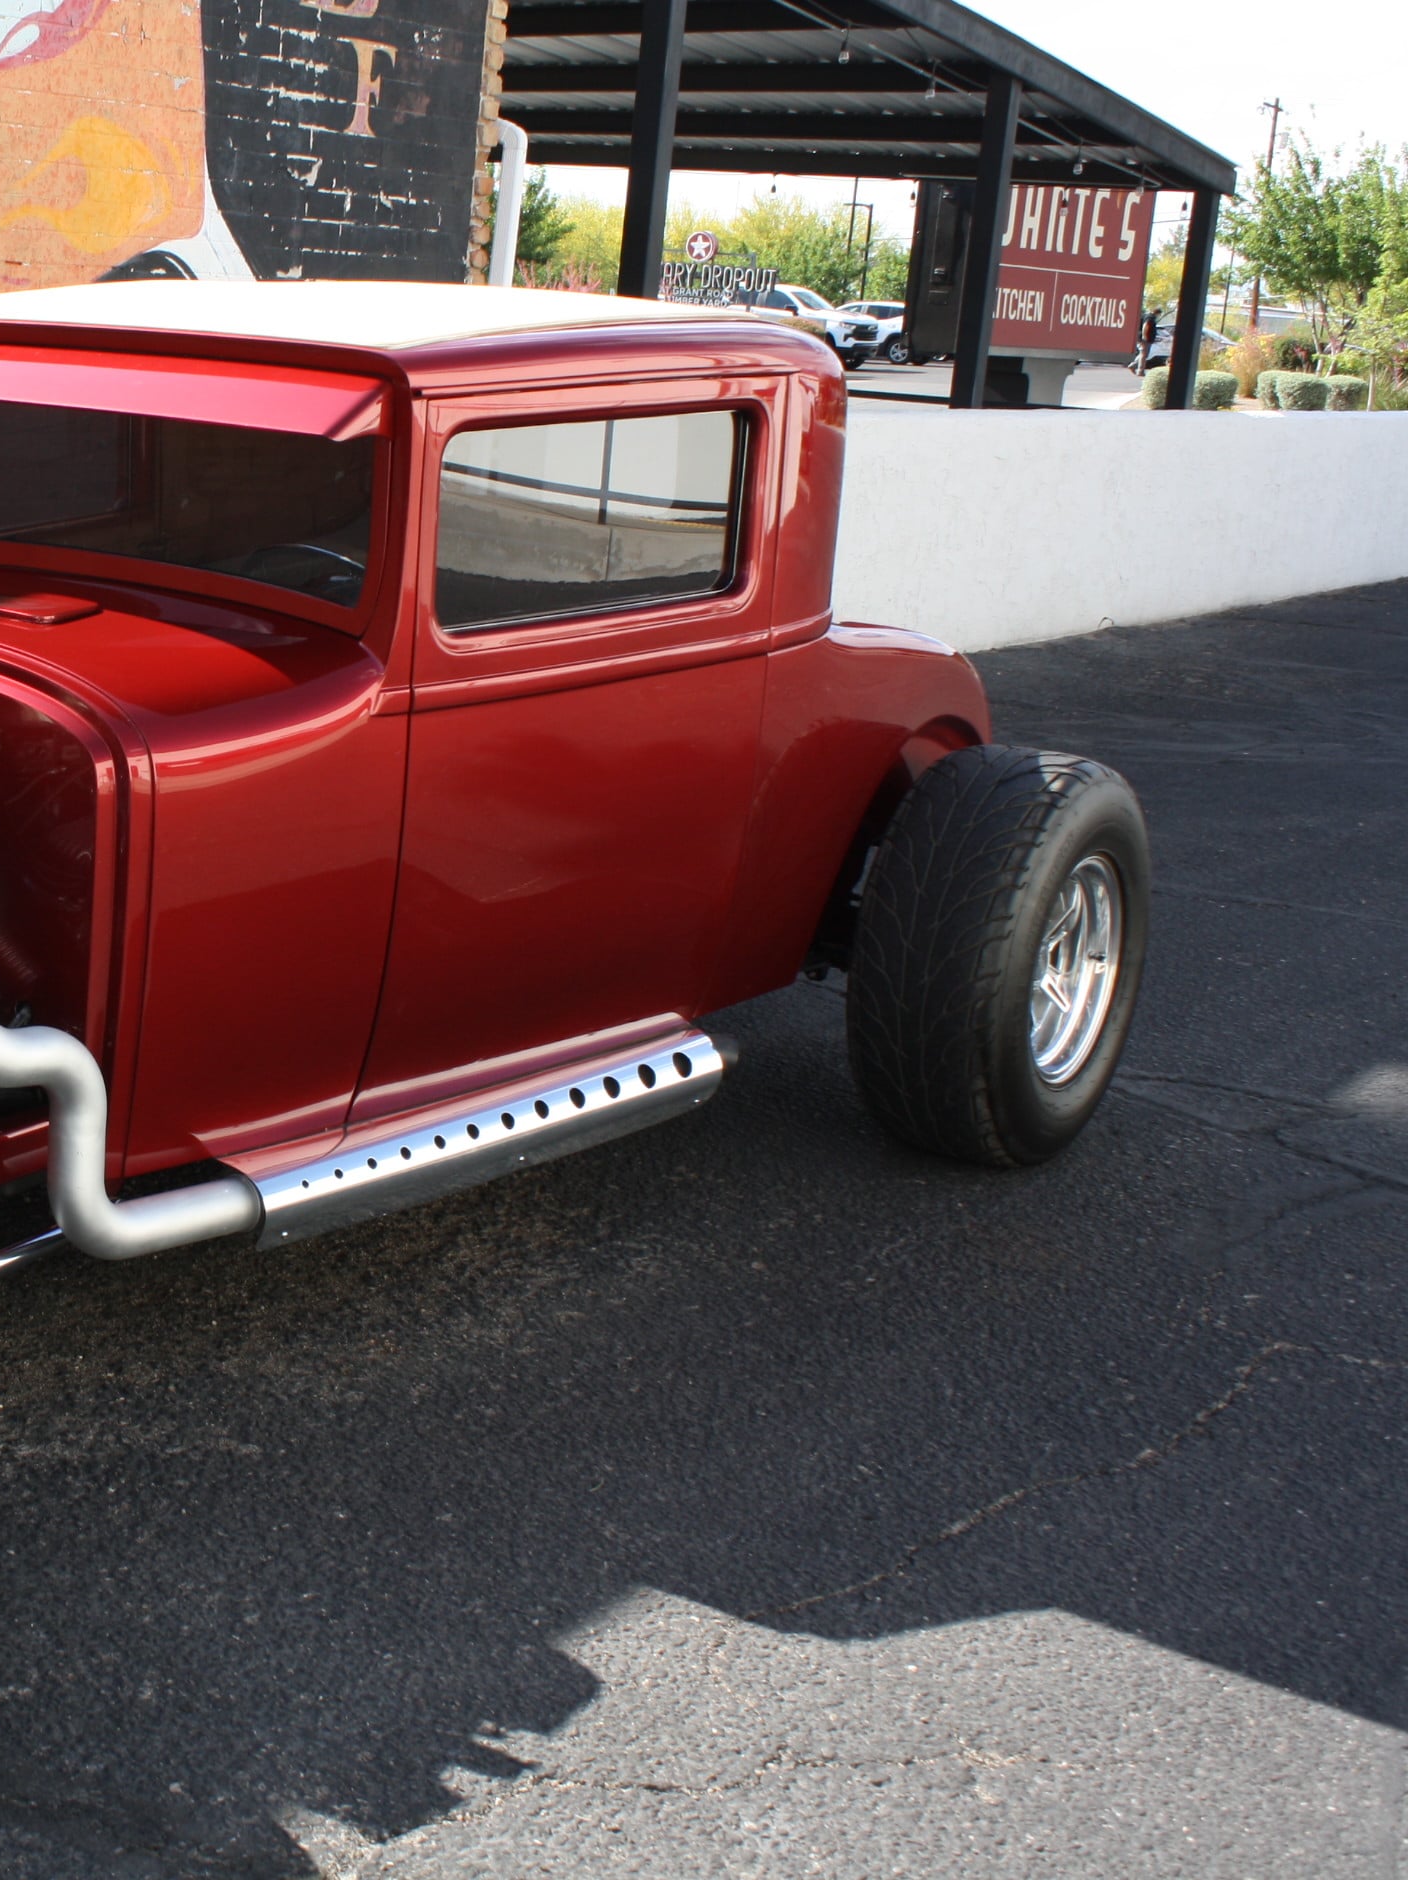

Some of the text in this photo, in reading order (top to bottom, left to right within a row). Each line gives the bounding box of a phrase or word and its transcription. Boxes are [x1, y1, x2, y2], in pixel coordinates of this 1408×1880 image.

[662, 263, 777, 292] ARY DROPOUT
[673, 287, 705, 297] GRANT
[707, 288, 733, 298] ROAD
[992, 287, 1045, 322] ITCHEN
[1060, 293, 1127, 329] COCKTAILS
